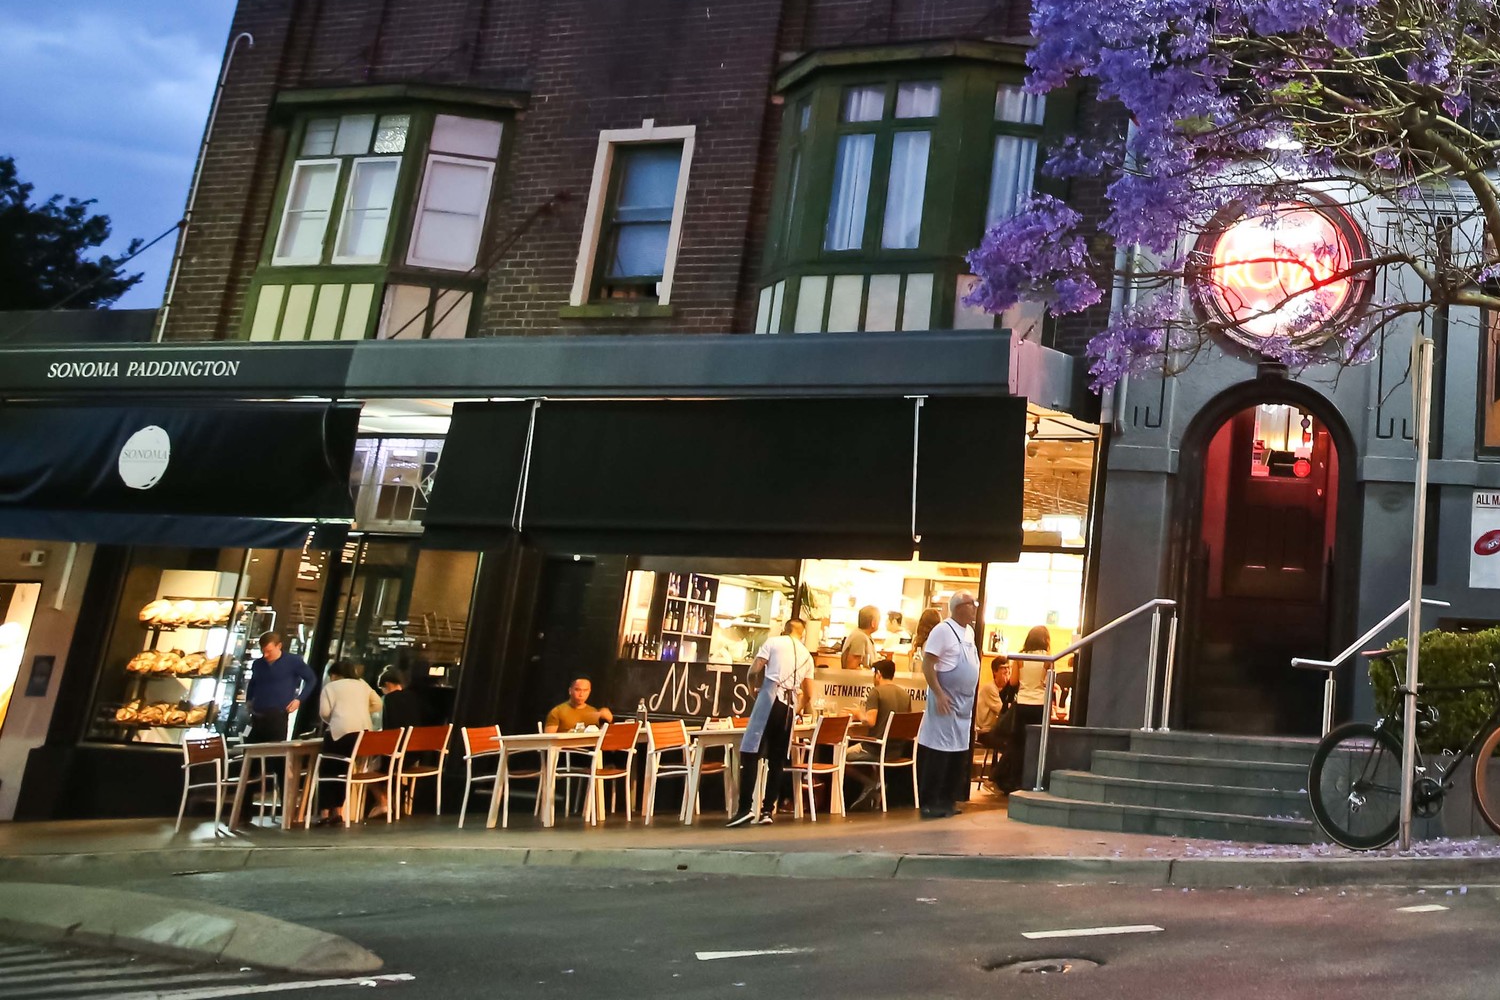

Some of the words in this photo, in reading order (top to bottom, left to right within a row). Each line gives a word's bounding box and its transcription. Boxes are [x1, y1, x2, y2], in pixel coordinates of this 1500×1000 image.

[47, 362, 119, 378] SONOMA
[126, 361, 240, 377] PADDINGTON
[1476, 494, 1490, 505] ALL
[706, 664, 749, 716] T's
[824, 684, 872, 698] VIETNAMES
